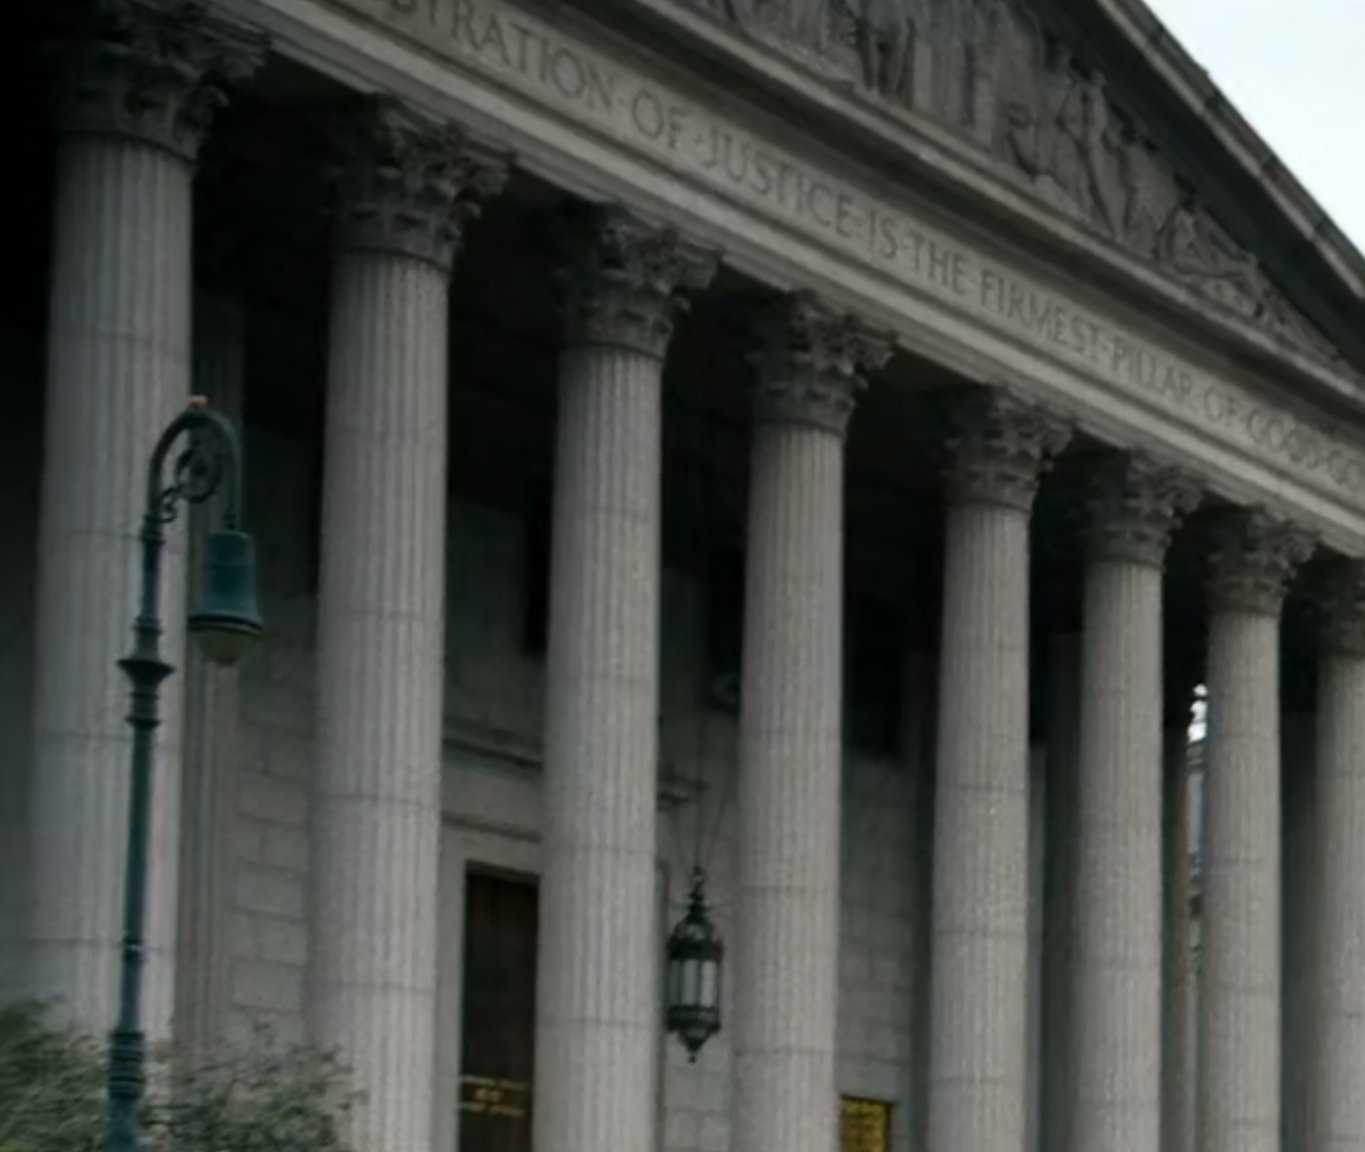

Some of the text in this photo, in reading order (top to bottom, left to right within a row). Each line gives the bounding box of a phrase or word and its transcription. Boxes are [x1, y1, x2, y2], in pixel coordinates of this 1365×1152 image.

[391, 0, 616, 110] RATION
[631, 87, 691, 150] OF
[700, 124, 854, 238] JUSTICE
[866, 207, 898, 260] IS
[908, 230, 971, 297] THE
[979, 267, 1102, 363] FIRMEST
[1112, 336, 1196, 404] PILLAR
